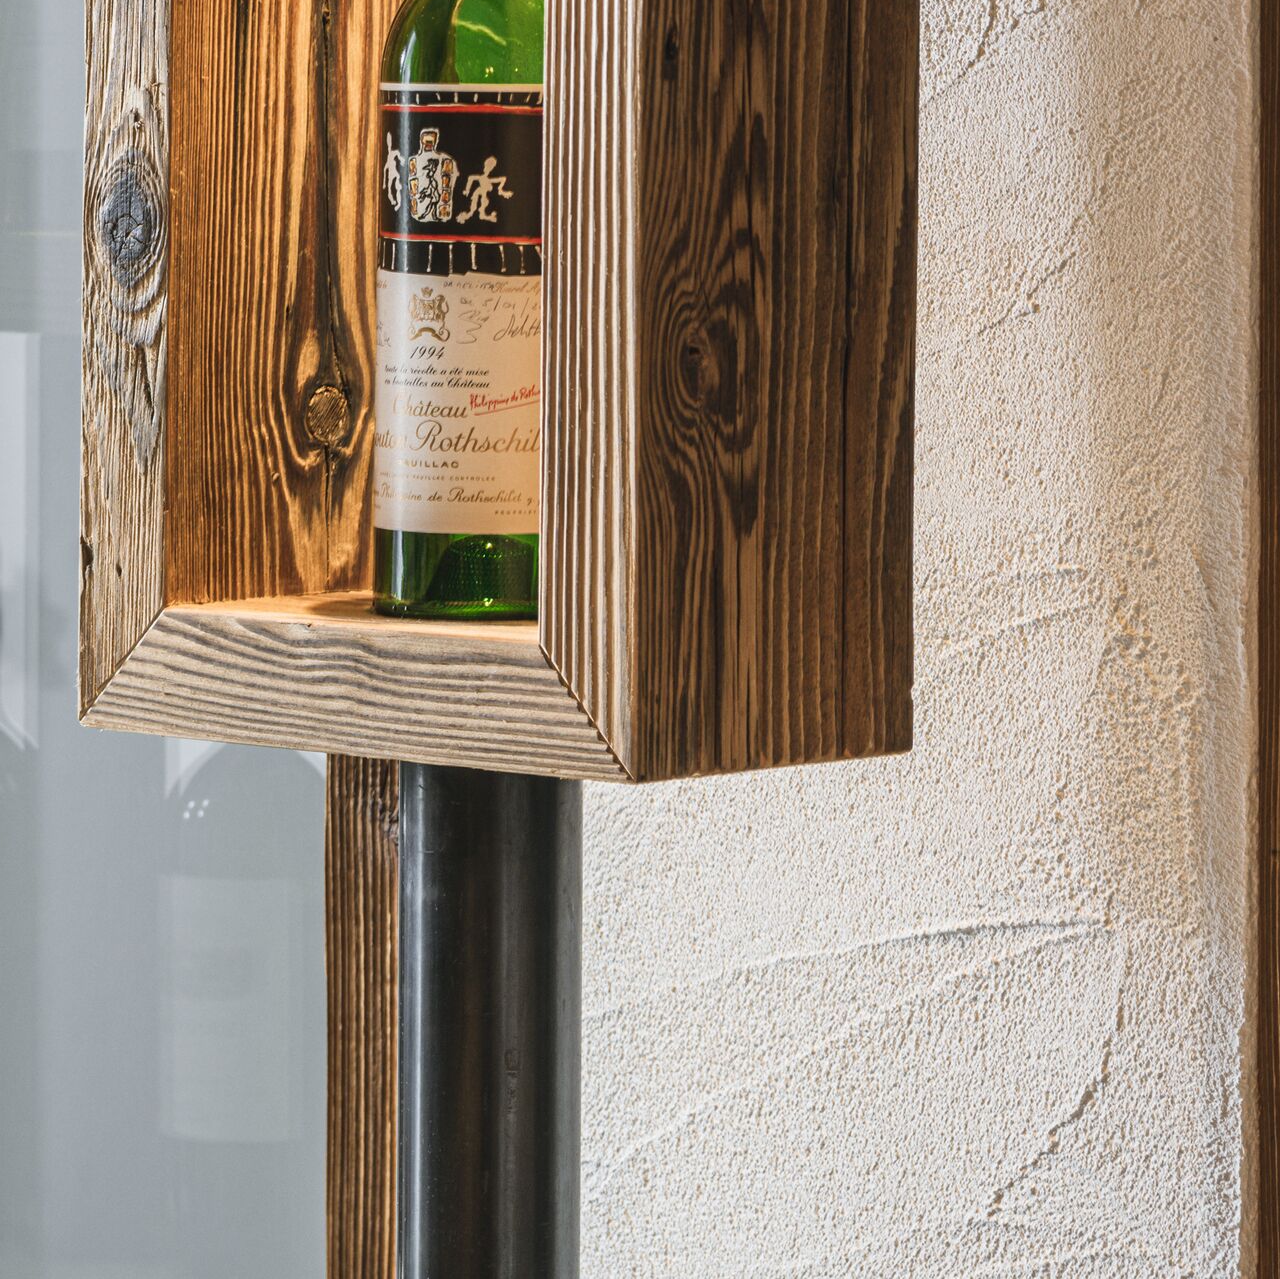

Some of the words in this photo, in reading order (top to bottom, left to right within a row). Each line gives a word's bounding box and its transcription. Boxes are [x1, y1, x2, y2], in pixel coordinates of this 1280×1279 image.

[409, 346, 446, 360] 1994
[410, 364, 437, 376] récolte
[449, 367, 463, 376] été
[465, 368, 490, 376] mise
[430, 380, 444, 388] au
[447, 377, 490, 388] Château
[410, 420, 540, 453] Rothschil
[403, 460, 459, 469] UILLAC
[427, 491, 442, 502] de
[447, 487, 522, 504] Rothschild
